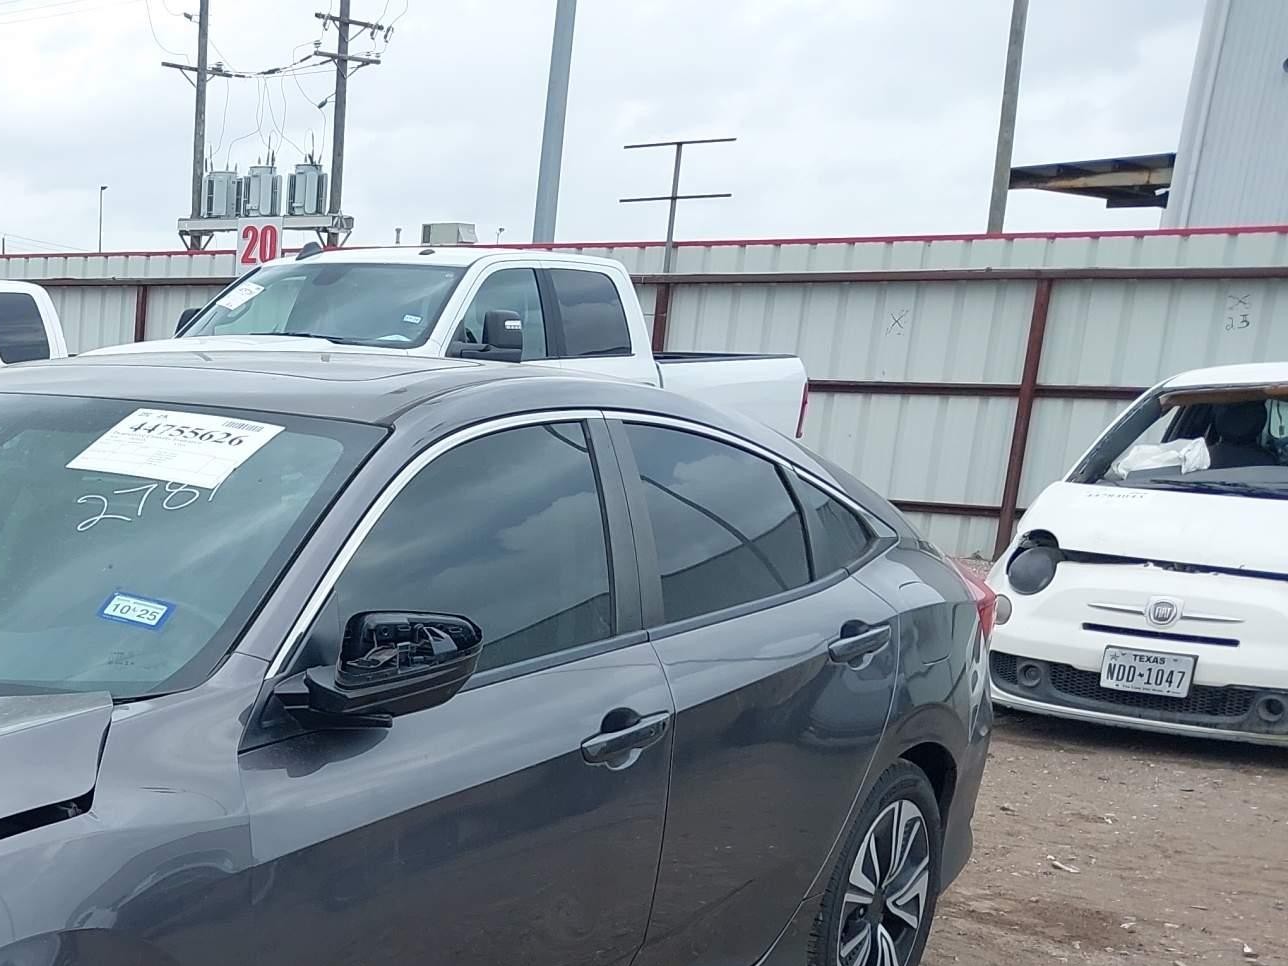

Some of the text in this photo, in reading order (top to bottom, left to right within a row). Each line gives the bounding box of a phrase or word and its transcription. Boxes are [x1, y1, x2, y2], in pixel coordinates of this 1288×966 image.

[240, 225, 277, 263] 20
[130, 421, 248, 447] 44755626
[112, 603, 132, 615] 10
[136, 608, 160, 621] 25
[1132, 653, 1166, 666] TEXAS
[1143, 667, 1186, 690] 1047
